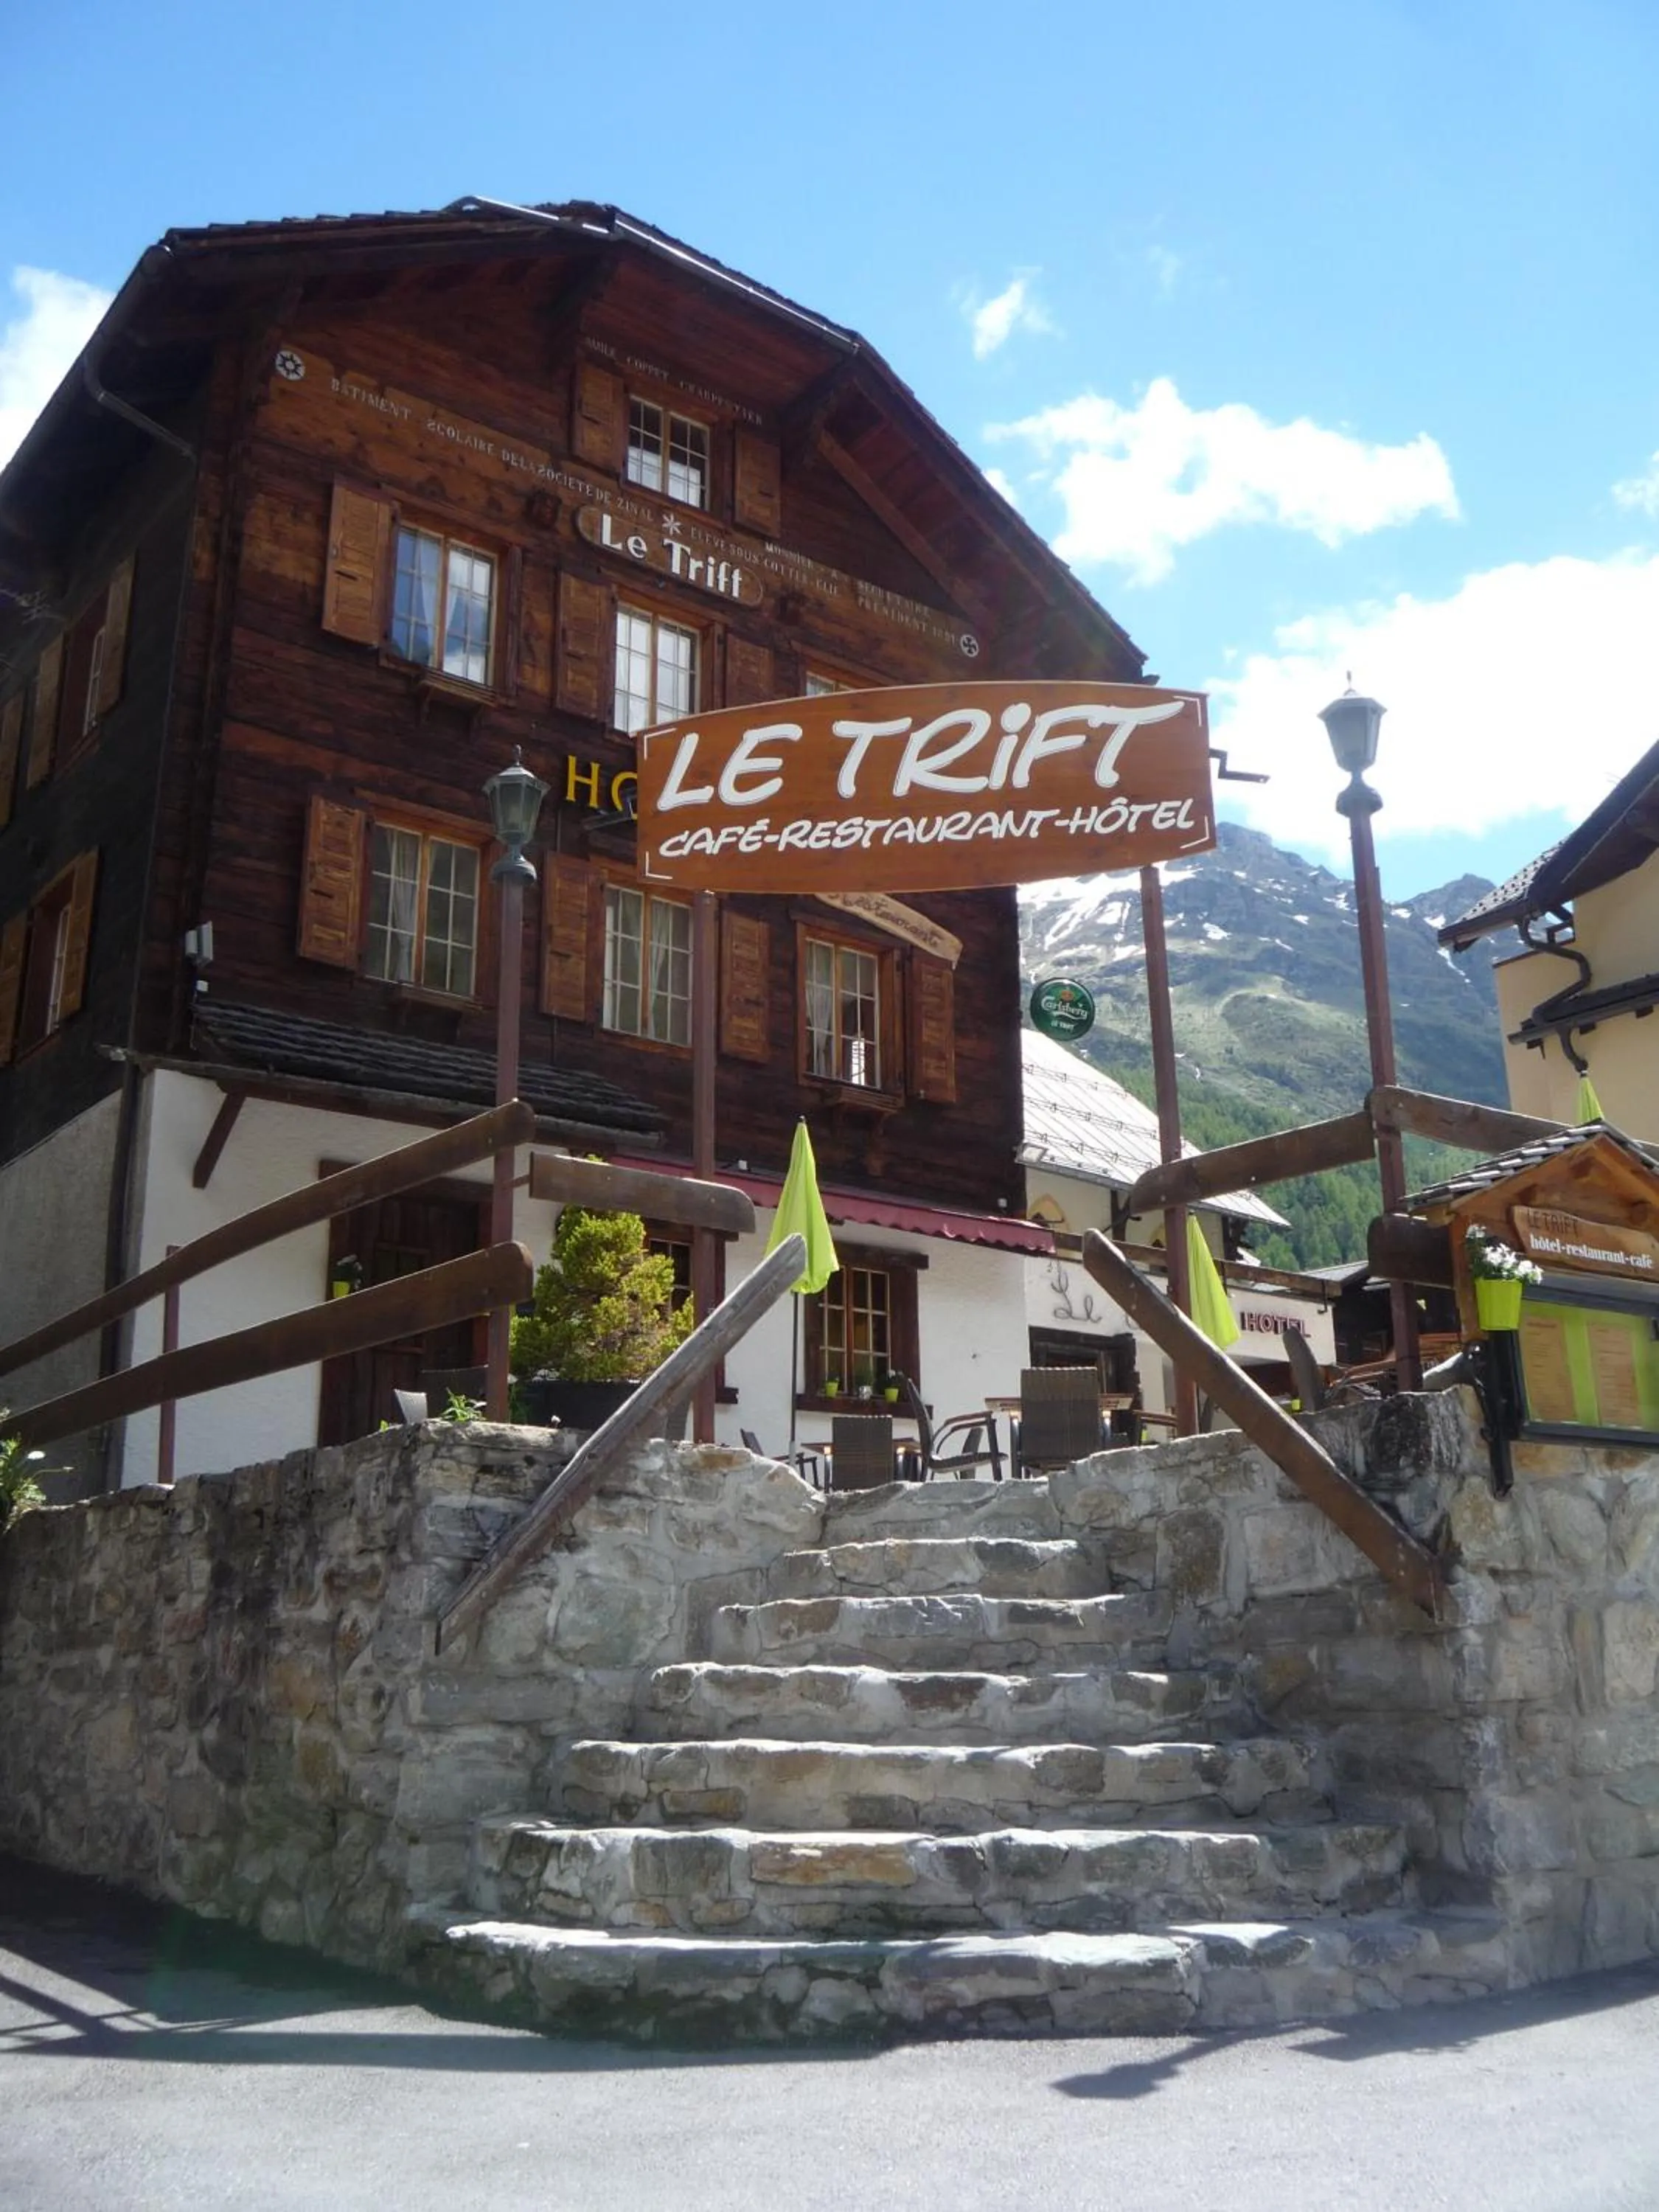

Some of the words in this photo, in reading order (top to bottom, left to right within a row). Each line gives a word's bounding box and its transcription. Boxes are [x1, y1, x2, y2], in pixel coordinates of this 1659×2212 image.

[330, 378, 412, 421] BATIMENT
[616, 495, 654, 522] ZINAL
[602, 513, 648, 559] Le
[663, 538, 742, 598] Trift
[657, 723, 803, 811] LE
[1041, 995, 1088, 1020] Carlsberg
[1528, 1208, 1540, 1229] LE
[1543, 1212, 1579, 1238] TRIFT
[1240, 1311, 1312, 1338] HOTEL
